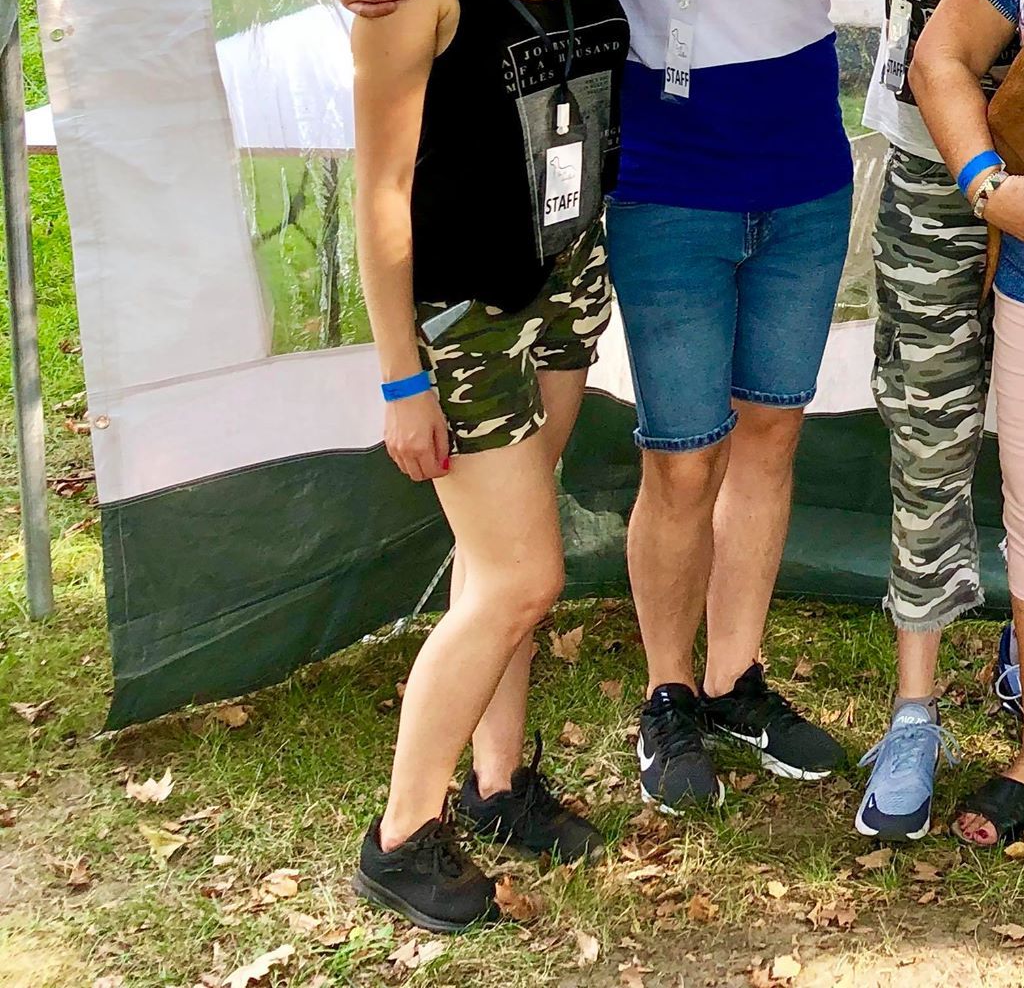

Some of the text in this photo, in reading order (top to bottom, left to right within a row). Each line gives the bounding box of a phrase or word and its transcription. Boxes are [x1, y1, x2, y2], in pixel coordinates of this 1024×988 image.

[666, 66, 689, 87] STAFF
[887, 59, 904, 77] STAFF
[506, 69, 555, 93] MILES
[545, 191, 579, 215] STAFF
